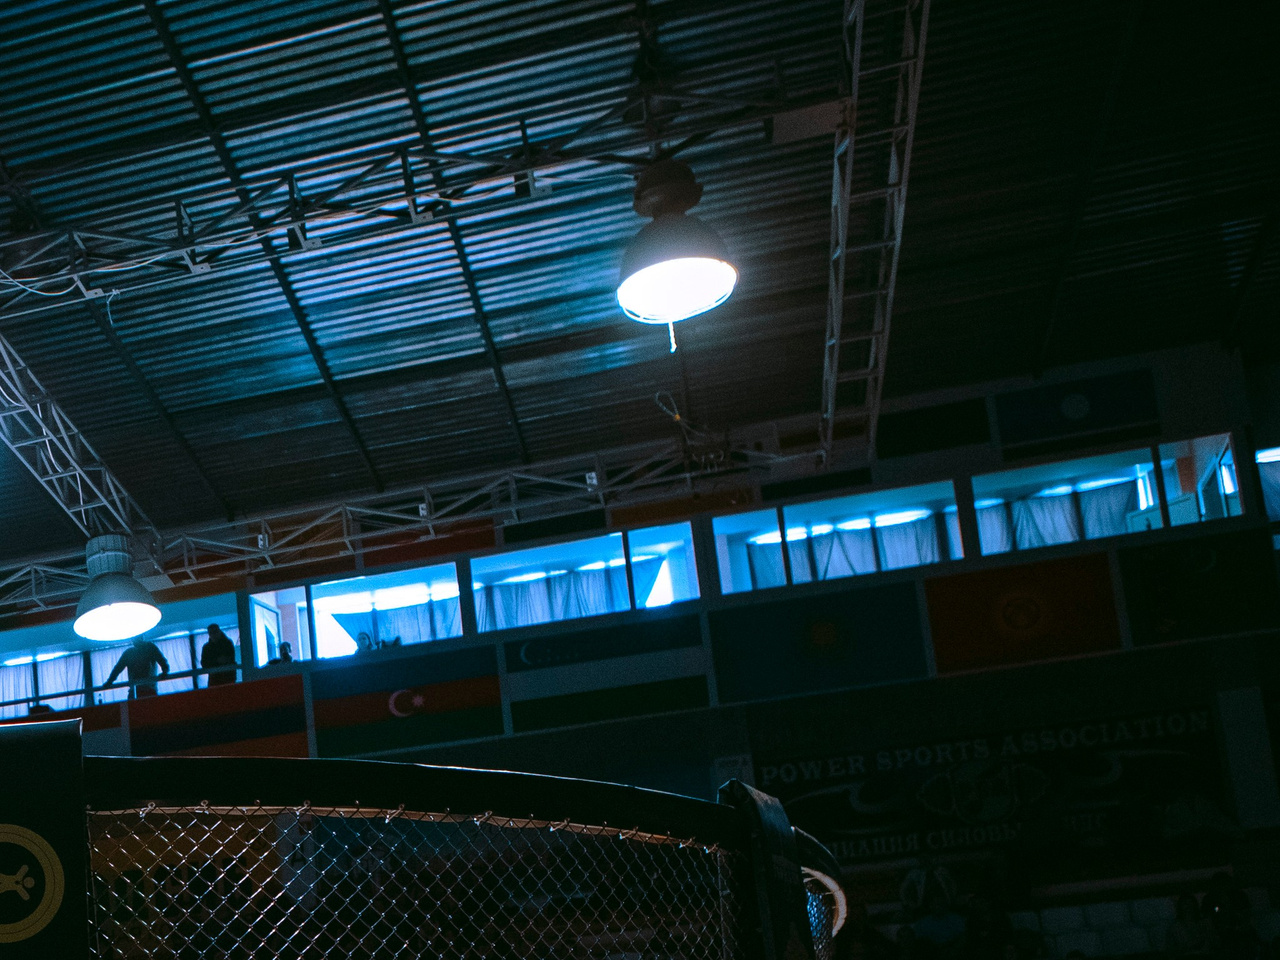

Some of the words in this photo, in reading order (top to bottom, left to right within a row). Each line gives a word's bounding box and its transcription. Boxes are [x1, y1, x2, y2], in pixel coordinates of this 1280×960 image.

[761, 753, 865, 786] POWER
[875, 737, 991, 771] SPORTS
[1000, 708, 1212, 755] ASSOCIATION
